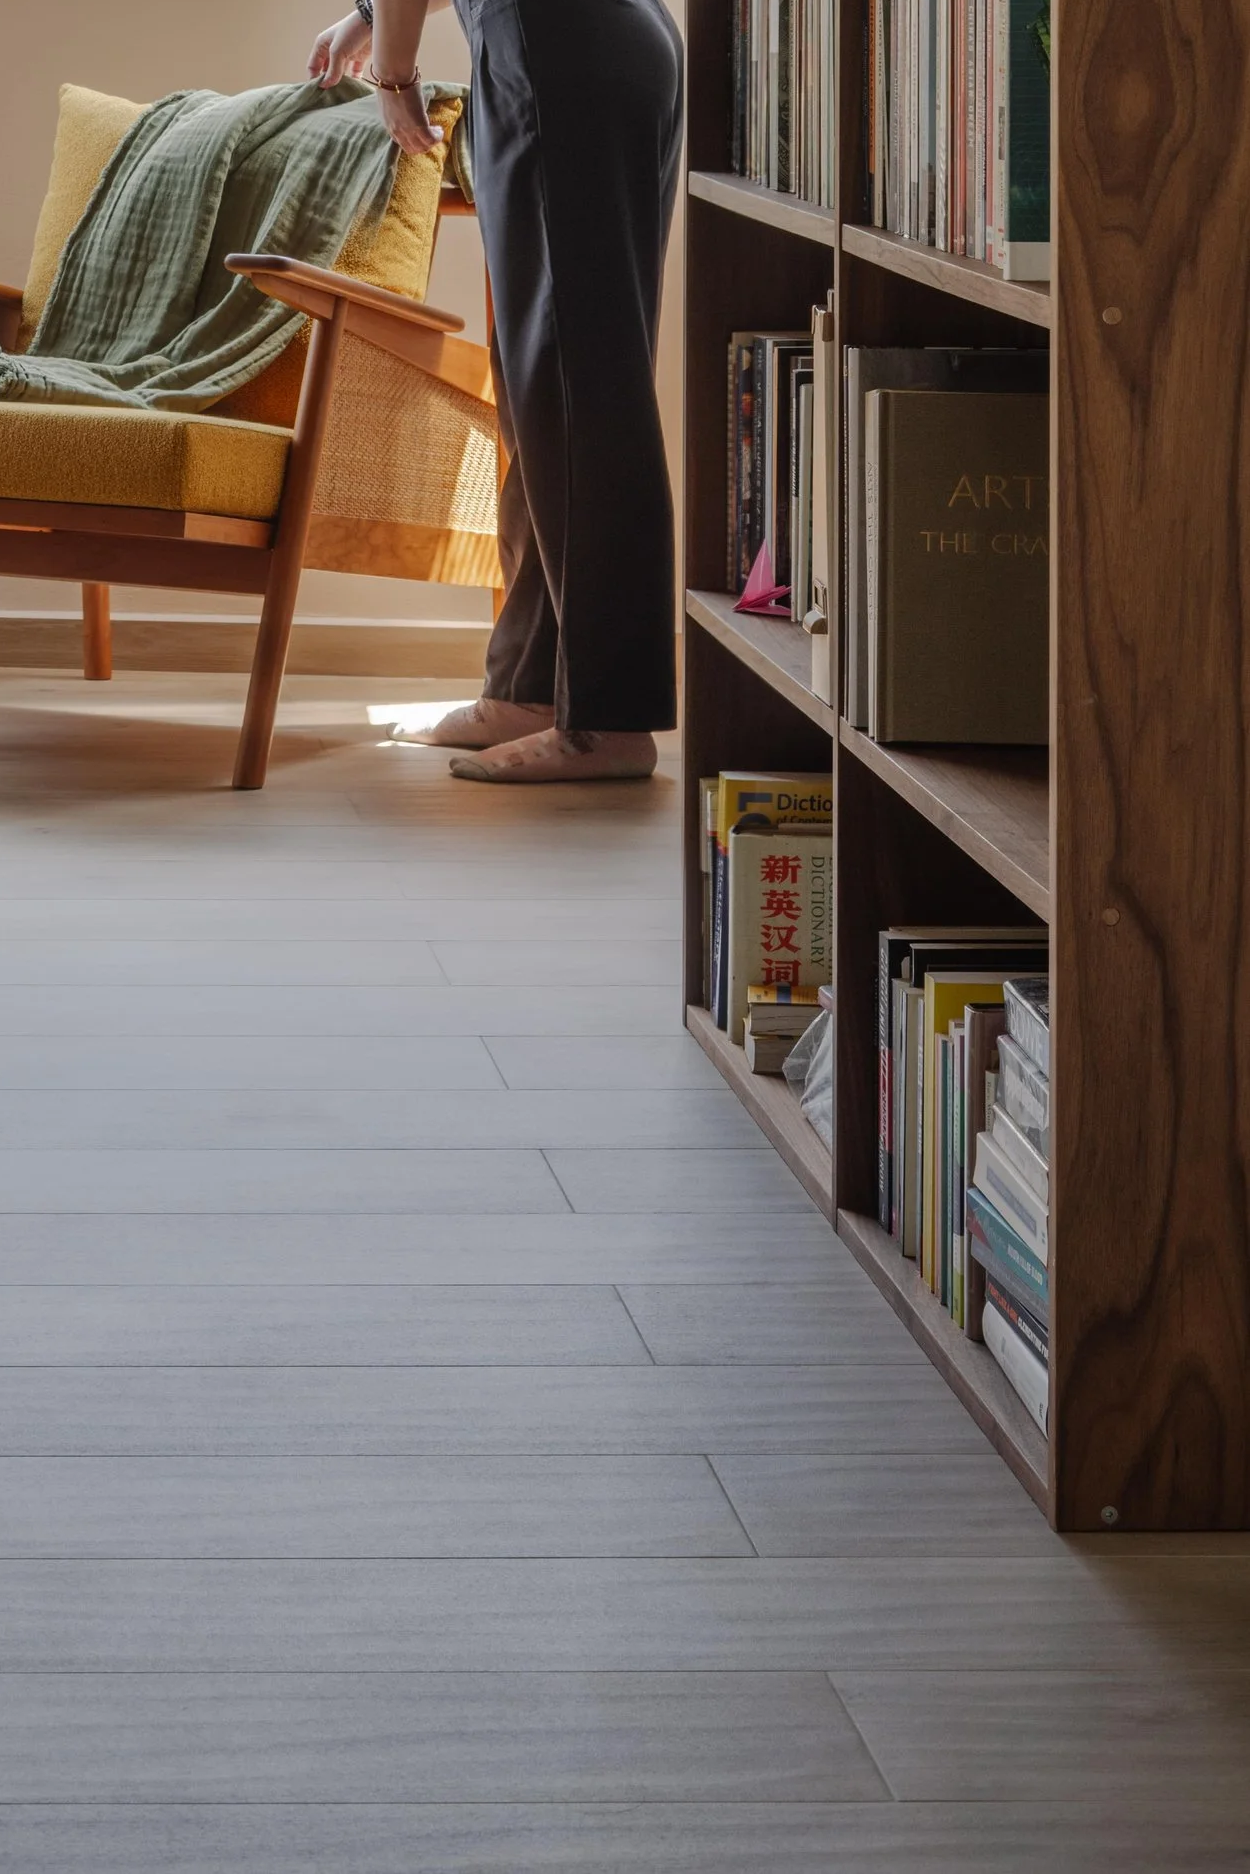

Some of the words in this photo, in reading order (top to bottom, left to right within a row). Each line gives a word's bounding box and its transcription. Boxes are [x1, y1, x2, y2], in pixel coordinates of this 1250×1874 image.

[948, 473, 1049, 510] ART
[919, 531, 979, 554] THE
[778, 794, 832, 811] Dictio
[760, 854, 802, 987] 新英汉词
[811, 856, 825, 968] DICTIONARY
[880, 948, 888, 1008] CATCH
[880, 1039, 888, 1079] KILL
[1018, 1316, 1042, 1353] CLEMENTINE
